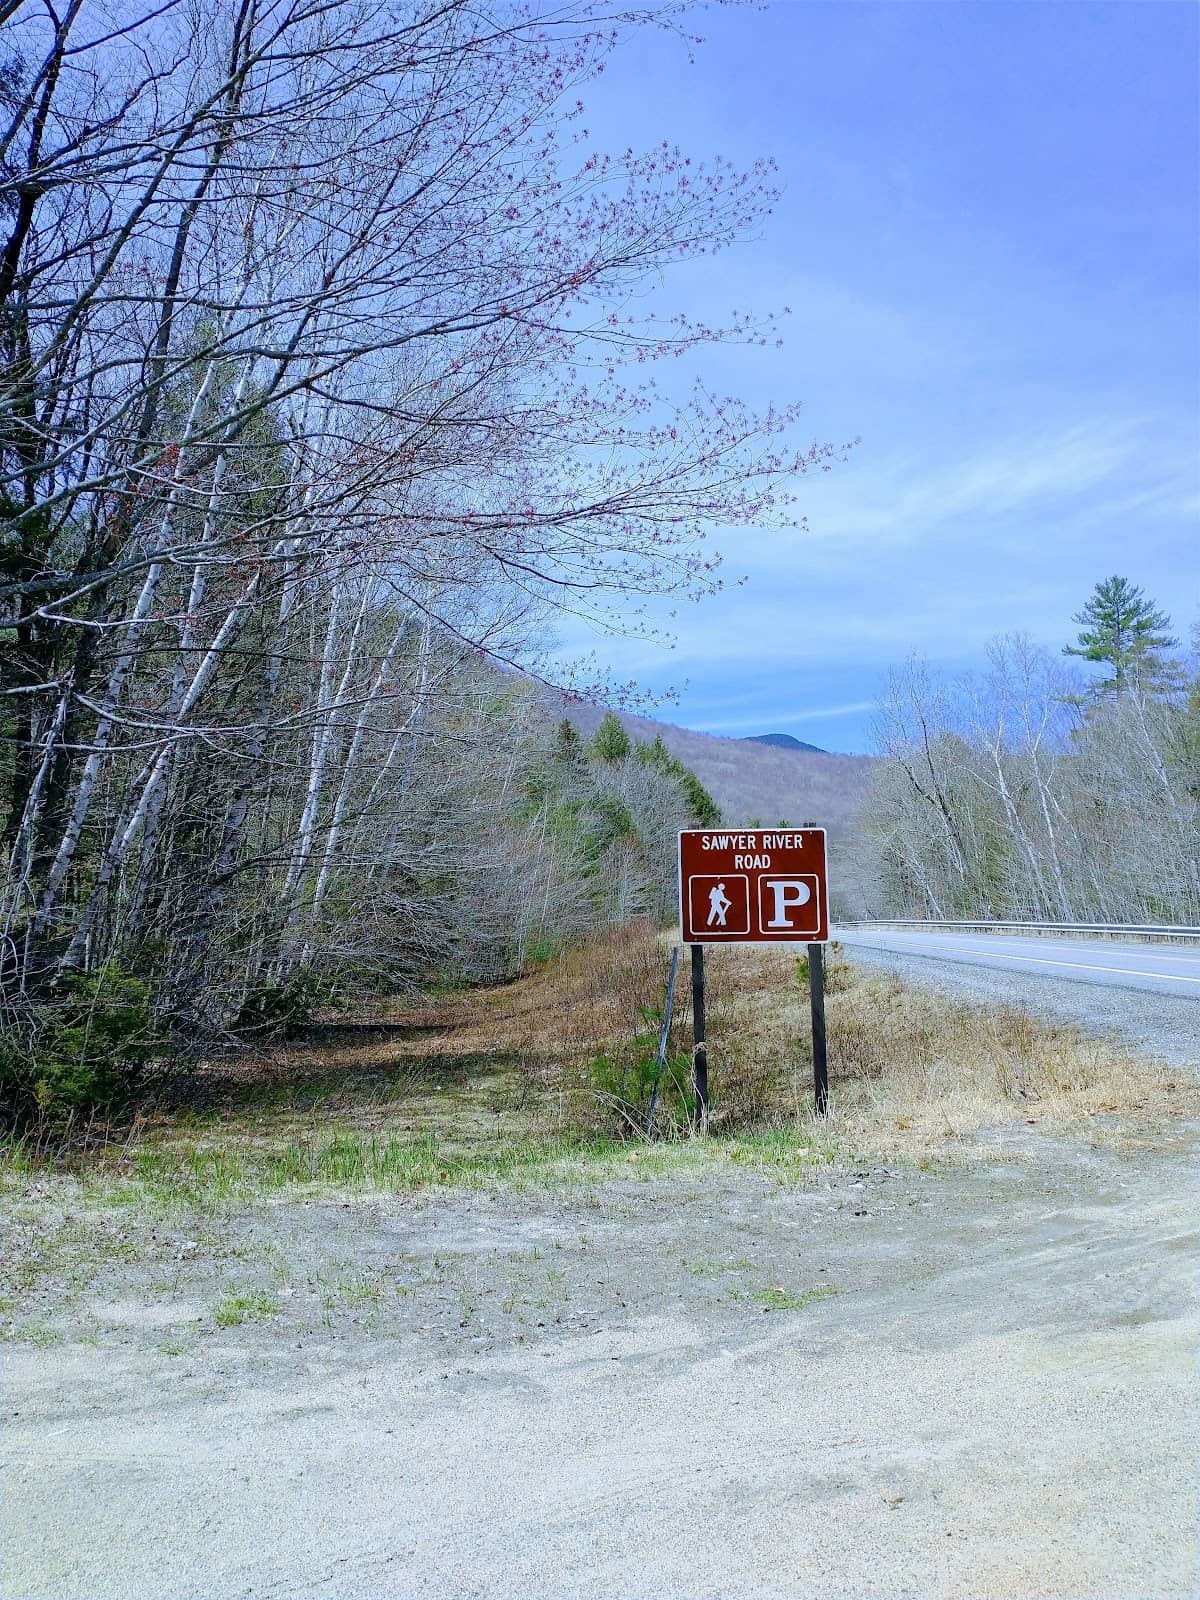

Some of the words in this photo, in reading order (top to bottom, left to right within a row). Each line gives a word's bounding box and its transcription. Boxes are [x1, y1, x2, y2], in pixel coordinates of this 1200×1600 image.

[701, 835, 756, 850] SAWYER
[763, 834, 803, 849] RIVER
[735, 854, 771, 869] ROAD
[766, 881, 811, 927] P
